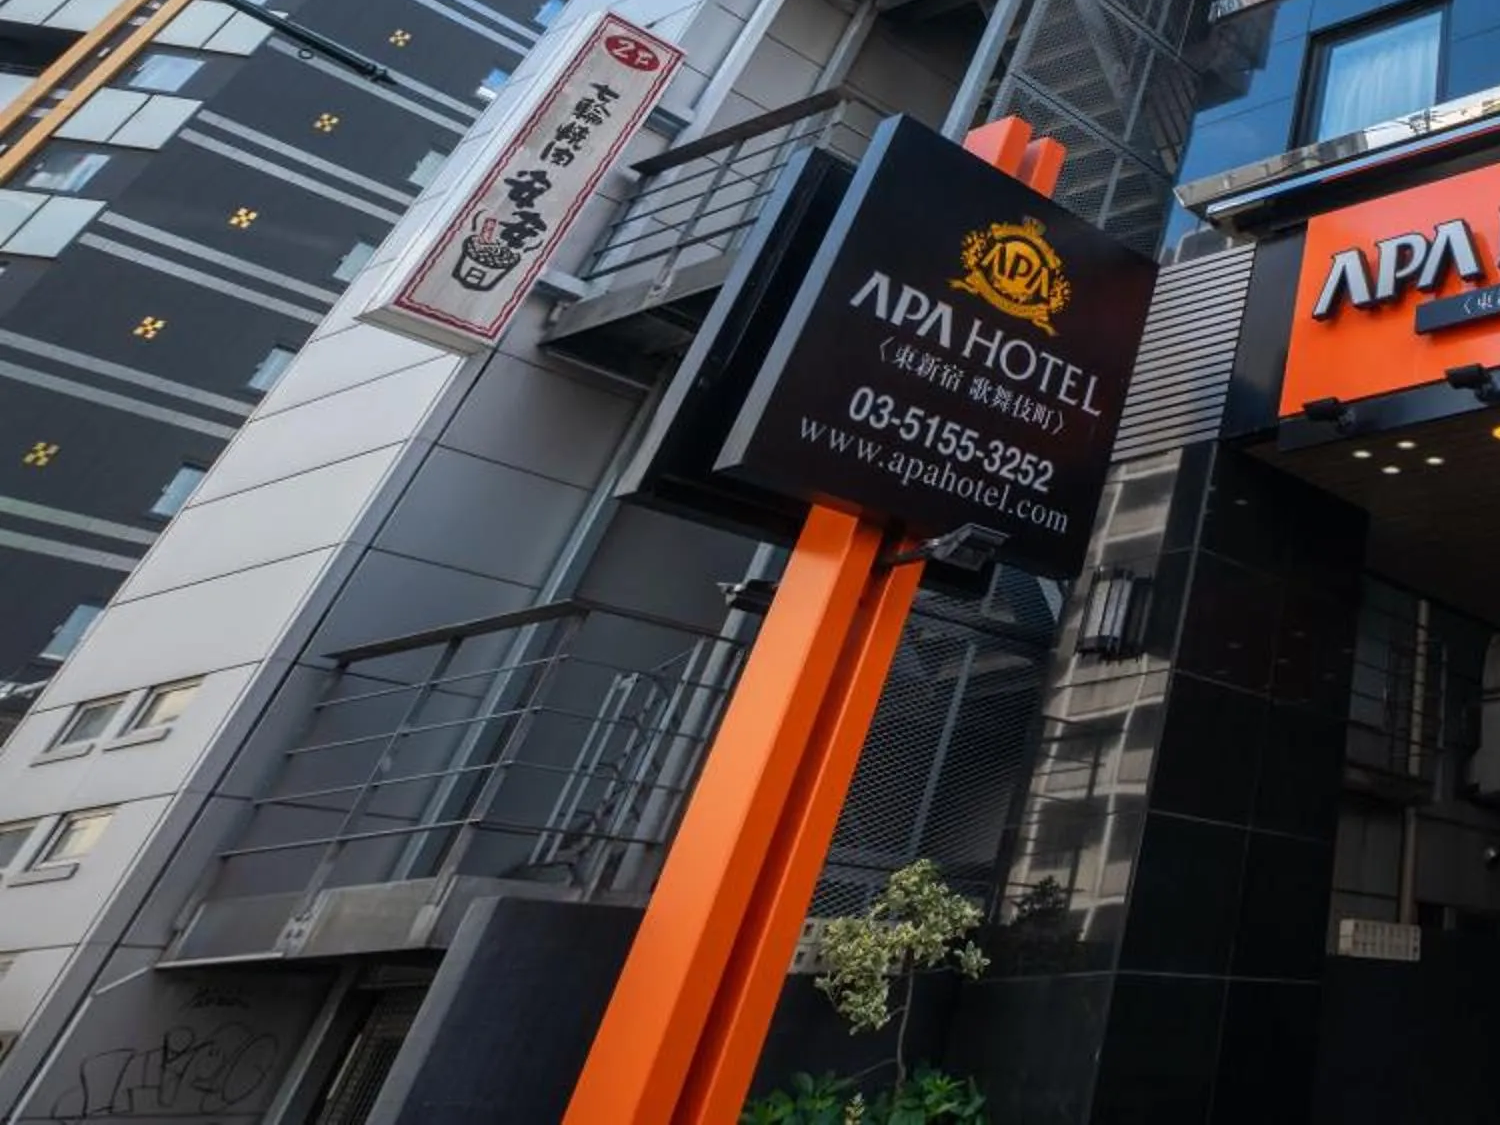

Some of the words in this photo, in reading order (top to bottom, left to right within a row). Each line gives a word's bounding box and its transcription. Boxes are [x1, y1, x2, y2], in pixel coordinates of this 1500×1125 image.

[1312, 218, 1482, 321] APA
[850, 270, 953, 350] APA
[963, 325, 1103, 416] HOTEL
[800, 416, 1069, 535] www.apahotel.com
[849, 386, 1055, 493] 03-5155-3252
